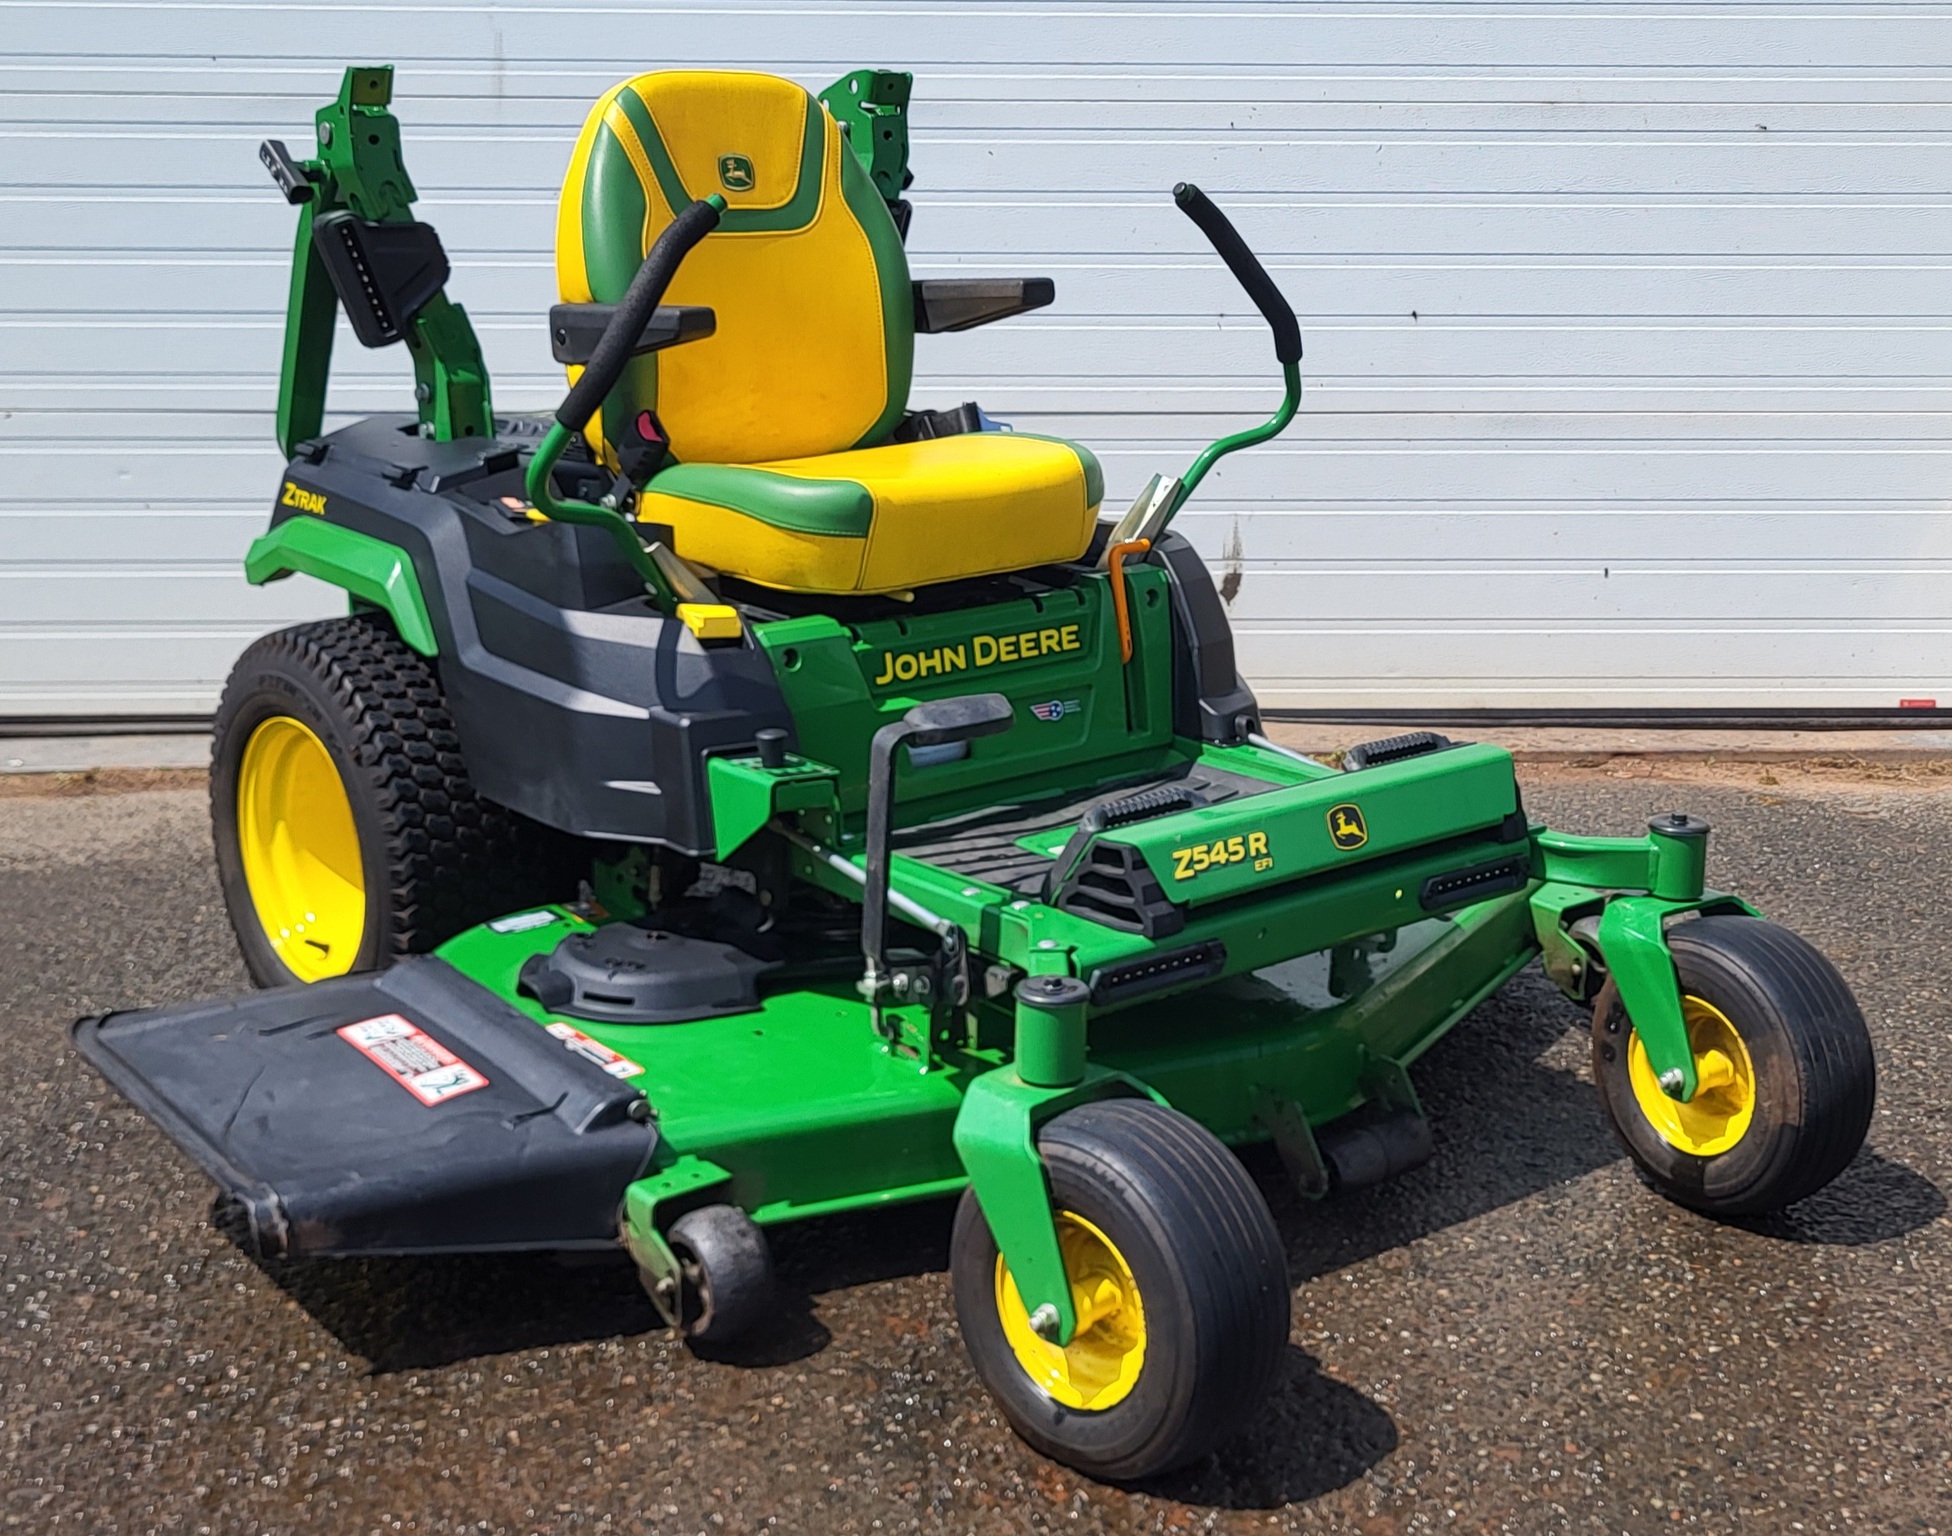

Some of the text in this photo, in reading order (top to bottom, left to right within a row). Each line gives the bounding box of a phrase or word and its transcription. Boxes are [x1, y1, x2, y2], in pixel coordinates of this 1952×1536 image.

[875, 624, 1081, 685] JOHN DEERE
[1171, 831, 1269, 881] Z545 R
